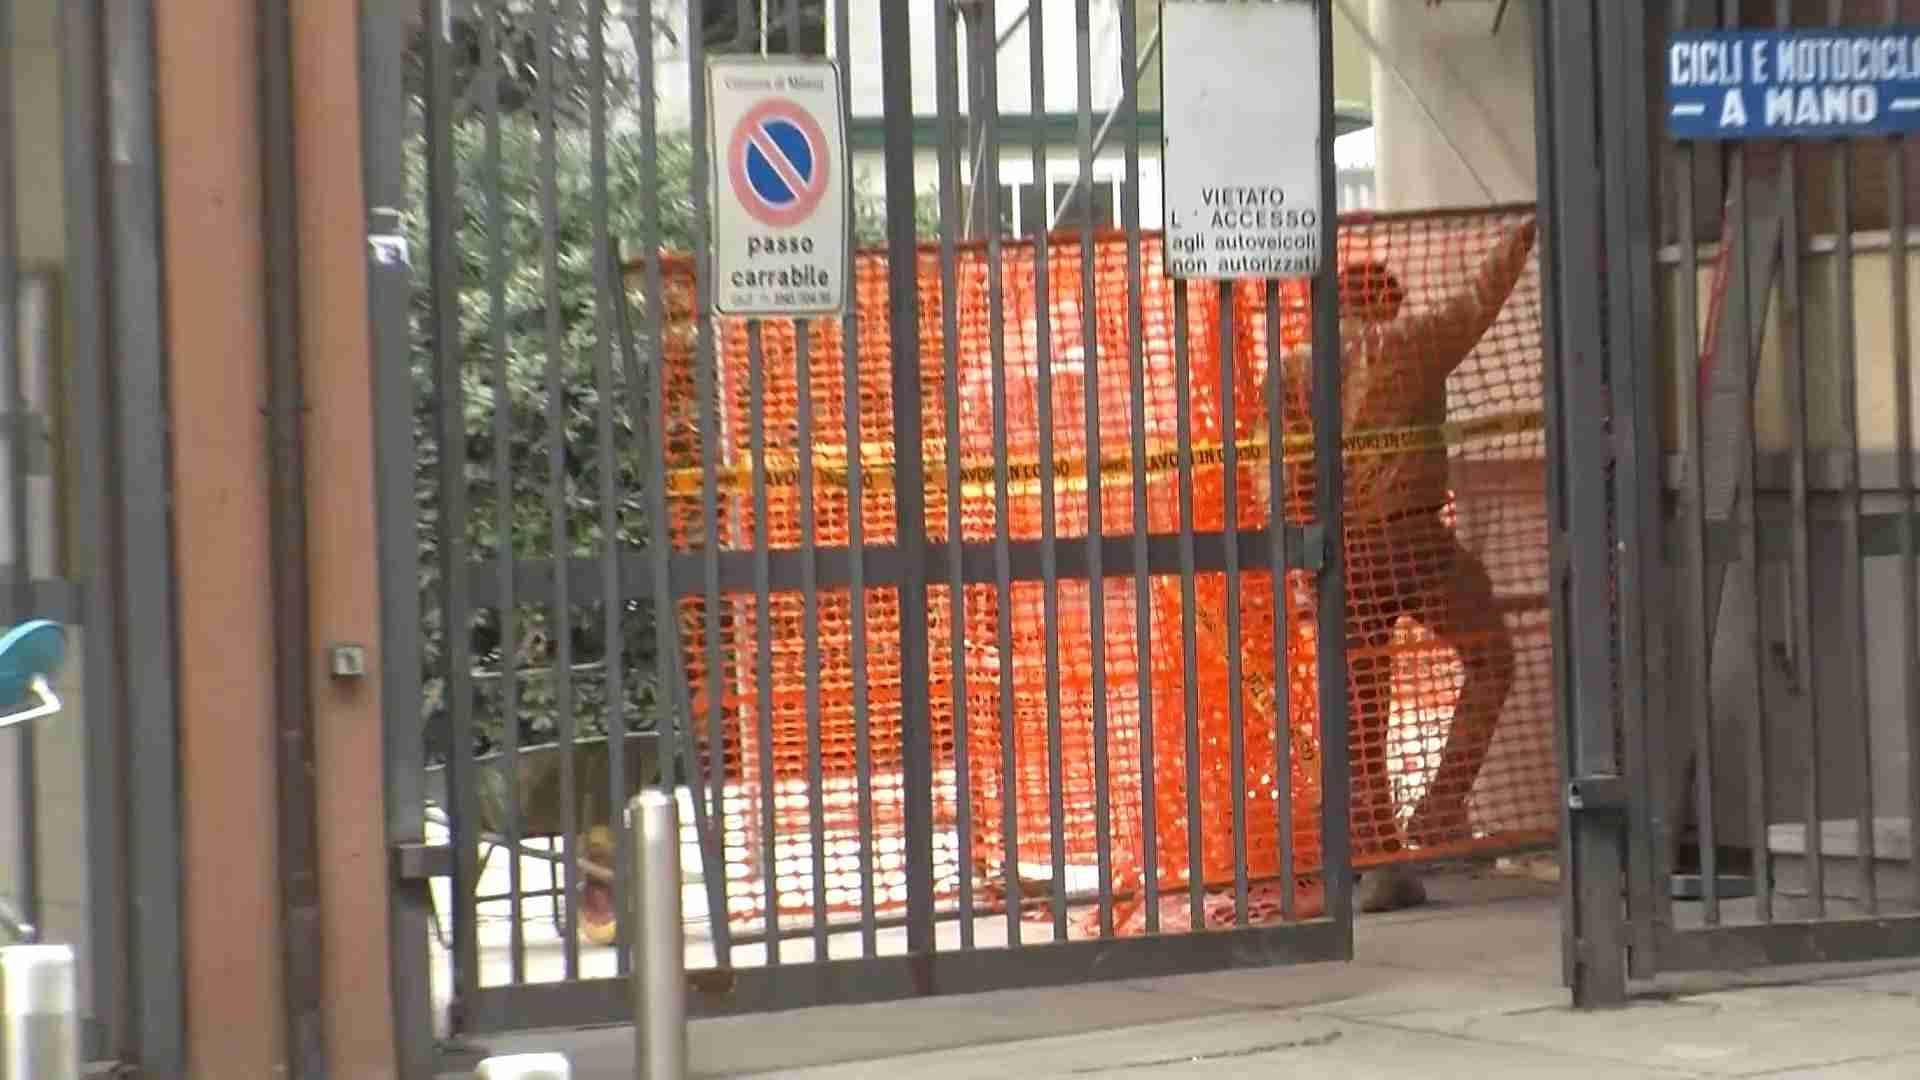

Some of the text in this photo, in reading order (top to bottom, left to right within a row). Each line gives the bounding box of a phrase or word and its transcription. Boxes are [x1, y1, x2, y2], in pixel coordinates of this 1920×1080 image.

[1671, 40, 1743, 85] CICLI
[1752, 40, 1768, 84] E
[1719, 85, 1878, 127] A MANO
[1201, 186, 1285, 206] VIETATO
[1211, 209, 1316, 229] ACCESSO
[747, 236, 814, 259] passo
[1172, 232, 1316, 254] agli autoveicoli
[1172, 255, 1318, 273] non autorizzati
[731, 264, 829, 288] carrabile
